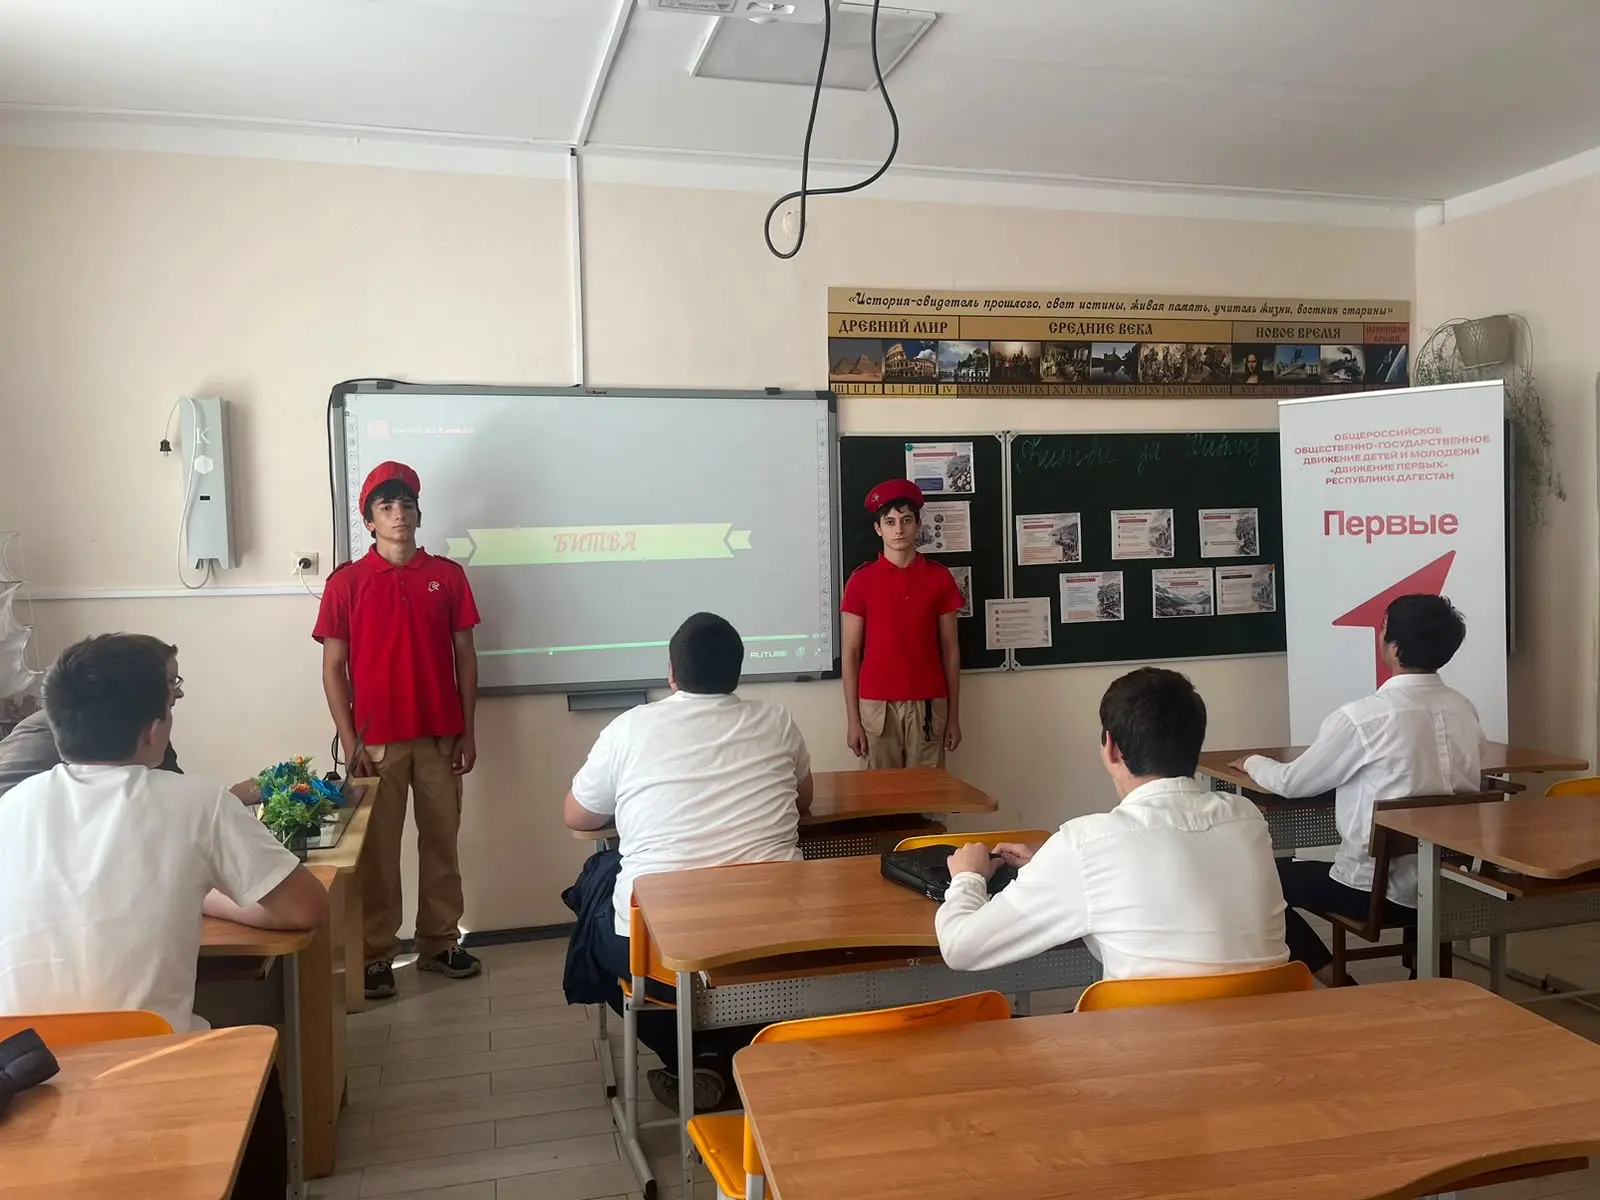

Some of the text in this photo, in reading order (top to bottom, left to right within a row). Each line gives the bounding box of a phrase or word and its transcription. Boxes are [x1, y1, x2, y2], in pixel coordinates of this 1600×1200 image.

[983, 299, 1041, 311] прошлого,
[1046, 297, 1074, 309] свет
[1079, 301, 1126, 311] истины,
[1130, 298, 1164, 311] живая
[1168, 303, 1210, 312] память,
[1213, 304, 1257, 316] учитель
[1260, 302, 1293, 317] жизни,
[1342, 306, 1394, 318] старины»
[838, 319, 949, 334] ДРЕВНИЙ МИР
[1048, 322, 1154, 336] СРЕДНИЕ ВЕКА
[1256, 326, 1341, 339] НОВОЕ ВРЕМЯ
[834, 384, 844, 392] III
[908, 385, 915, 393] II
[923, 385, 933, 393] III
[942, 385, 953, 393] IV
[1334, 426, 1442, 441] ОБЩЕРОССИЙСКОЕ
[1294, 435, 1491, 454] ОБЩЕСТВЕННО-ГОСУДАРСТВЕННОЕ
[1303, 447, 1480, 466] ДВИЖЕНИЕ ДЕТЕЙ И МОЛОДЕЖИ
[1330, 460, 1449, 474] «ДВИЖЕНИЕ ПЕРВЫХ»
[1325, 471, 1455, 485] РЕСПУБЛИКИ ДАГЕСТАН
[1323, 510, 1459, 544] Первые
[553, 531, 639, 553] БИТВА
[750, 650, 788, 659] RUTUBE
